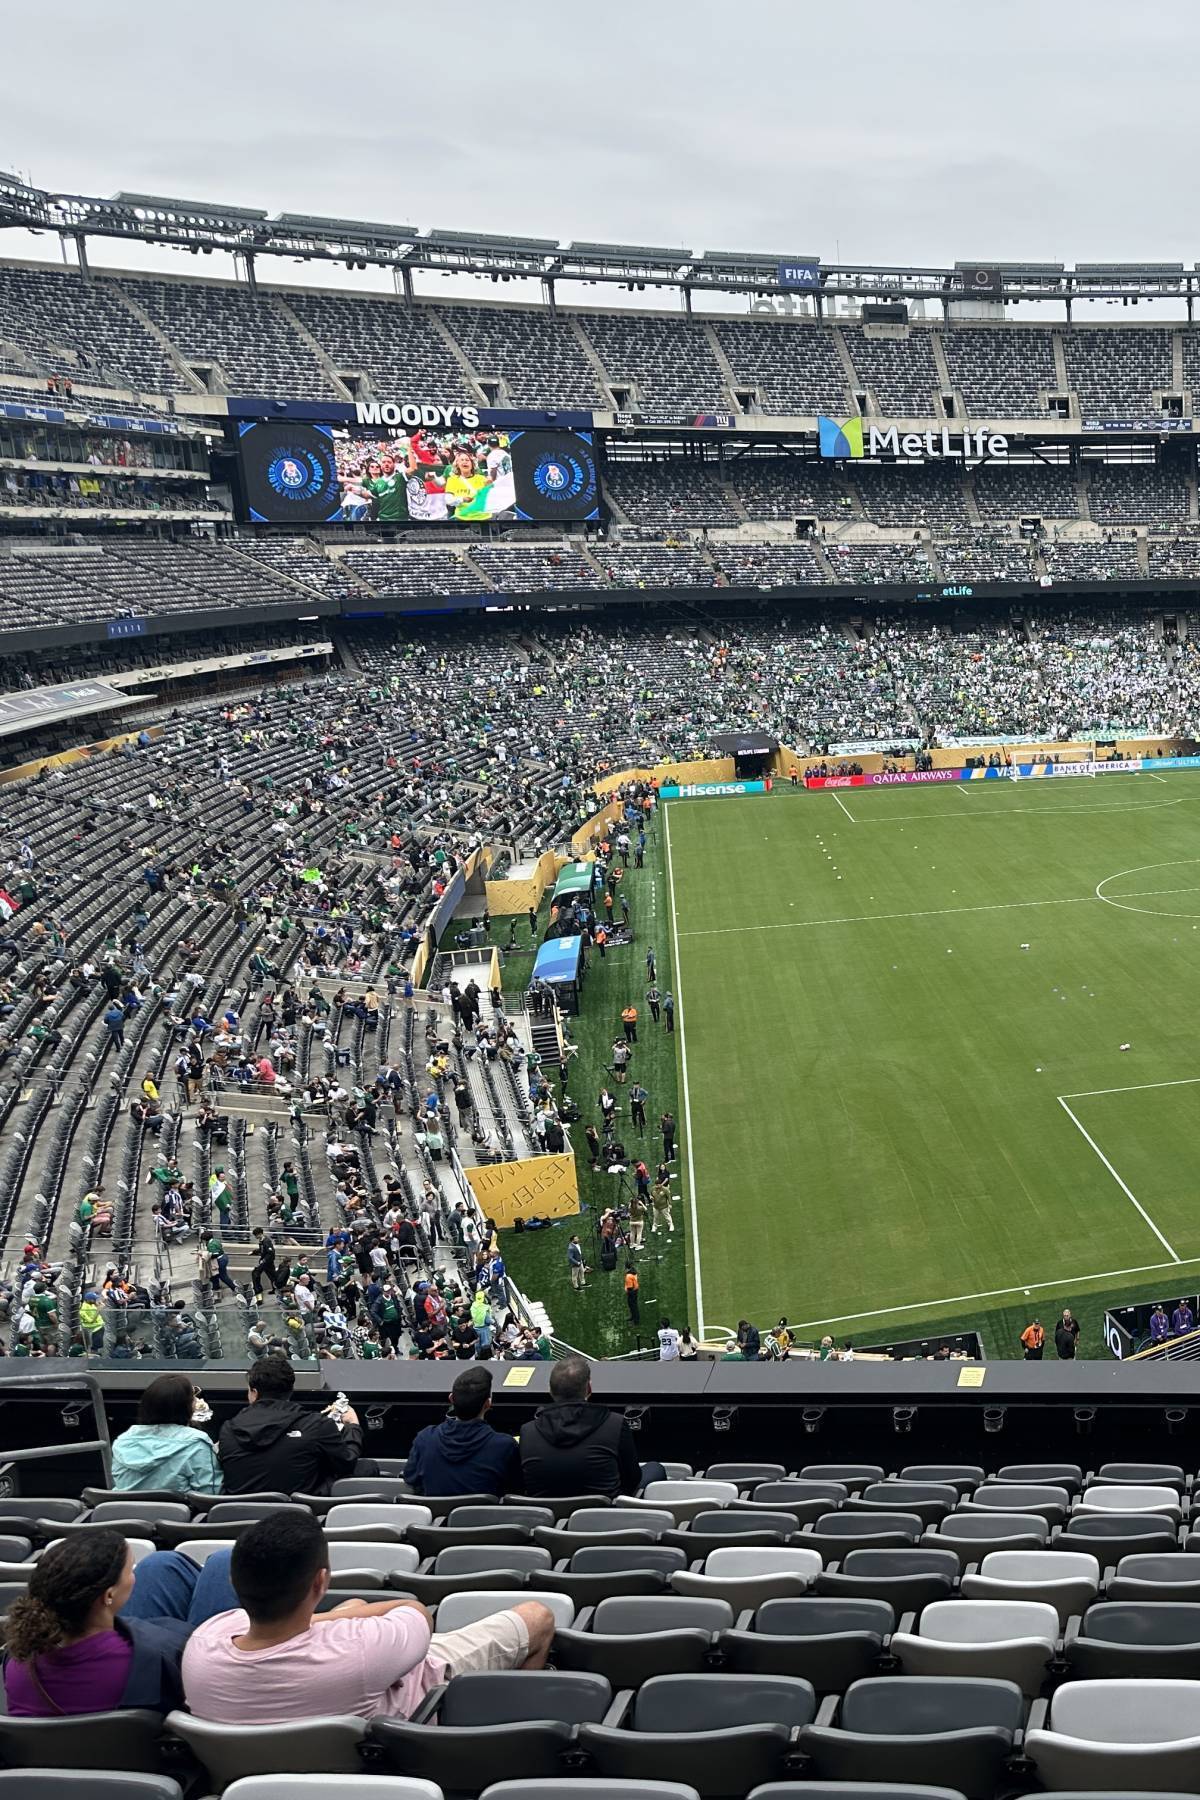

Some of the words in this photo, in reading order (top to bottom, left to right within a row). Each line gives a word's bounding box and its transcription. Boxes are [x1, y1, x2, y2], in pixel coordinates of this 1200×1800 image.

[784, 268, 812, 280] FIFA
[356, 403, 480, 428] MOODY'S
[869, 425, 1009, 457] MetLife
[1054, 763, 1077, 772] BANK
[1092, 761, 1130, 771] AMERICA
[872, 773, 908, 784] QATAR
[911, 769, 953, 781] AIRWAYS
[679, 782, 746, 797] Hisense
[662, 1338, 672, 1346] 23
